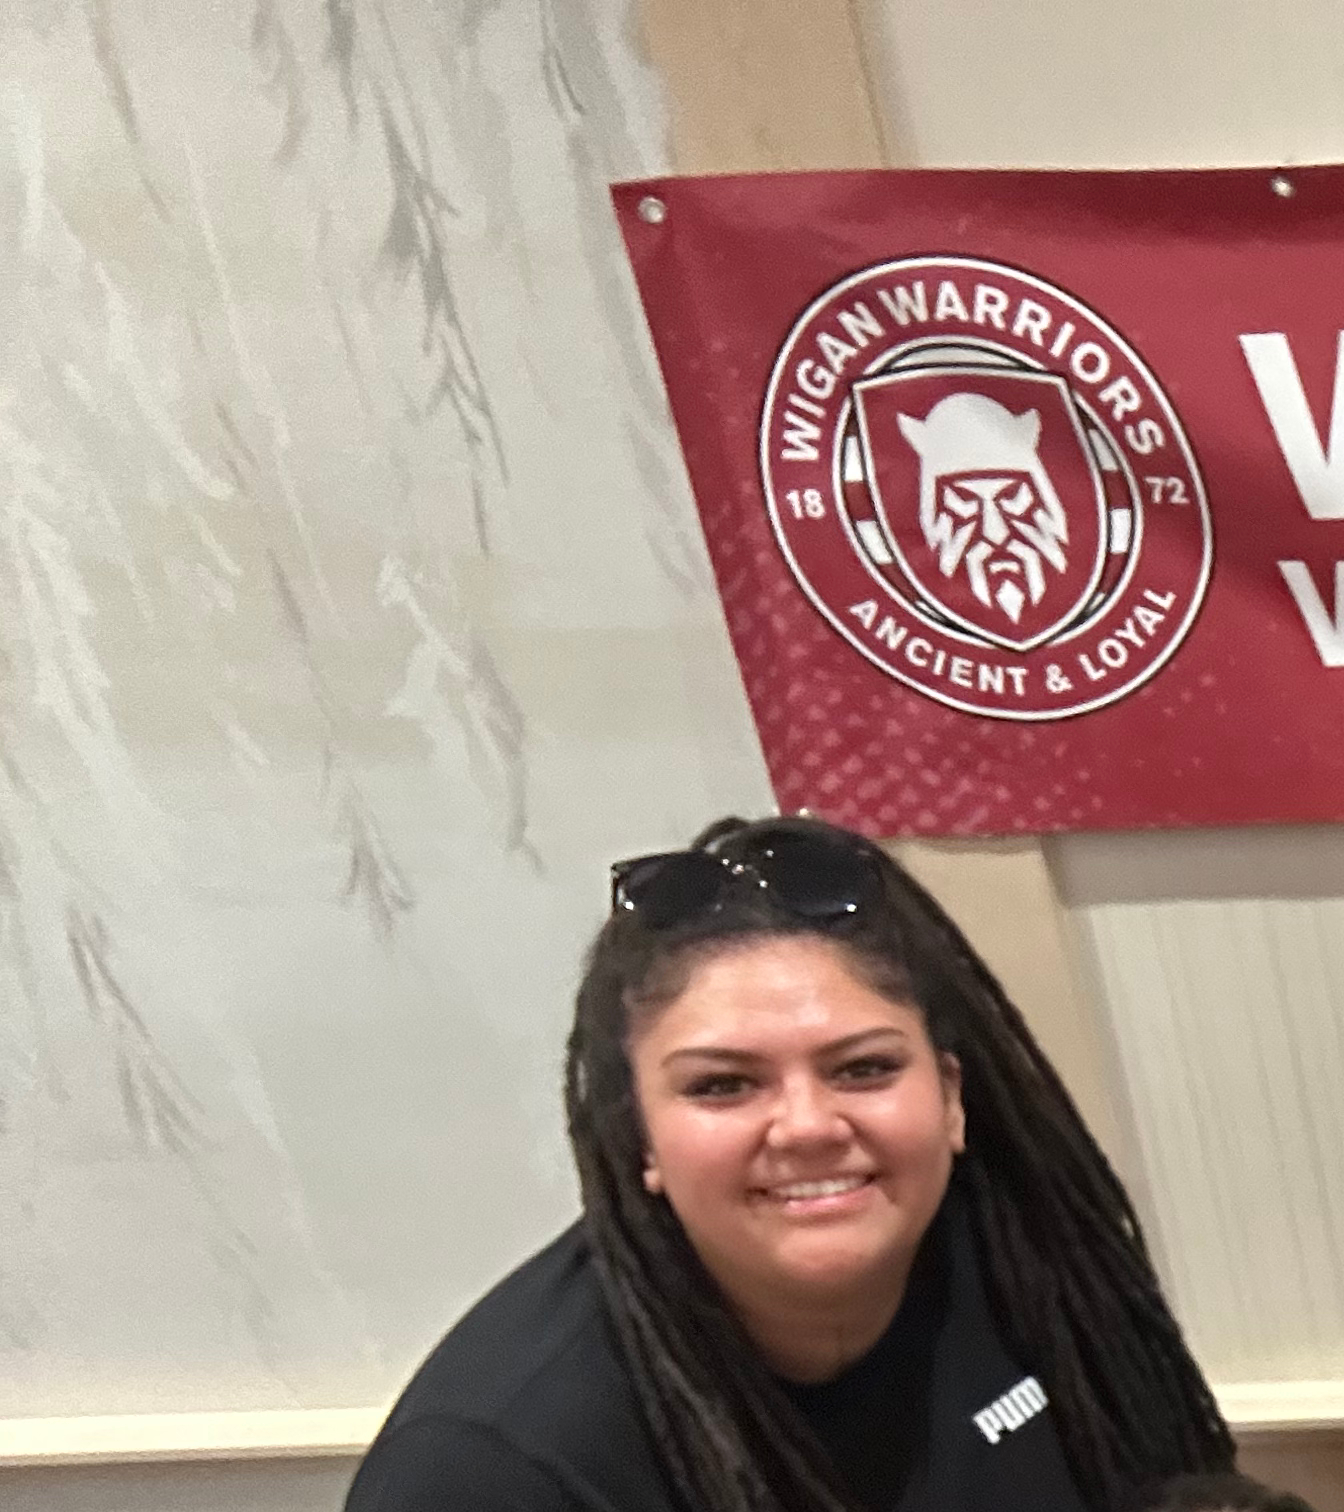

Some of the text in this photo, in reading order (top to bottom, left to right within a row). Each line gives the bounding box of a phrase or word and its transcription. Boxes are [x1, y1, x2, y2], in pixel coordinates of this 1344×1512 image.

[781, 280, 1164, 462] WIGAN WARRIORS
[786, 476, 1189, 520] 18 72
[849, 588, 1176, 696] ANCIENT & LOYAL
